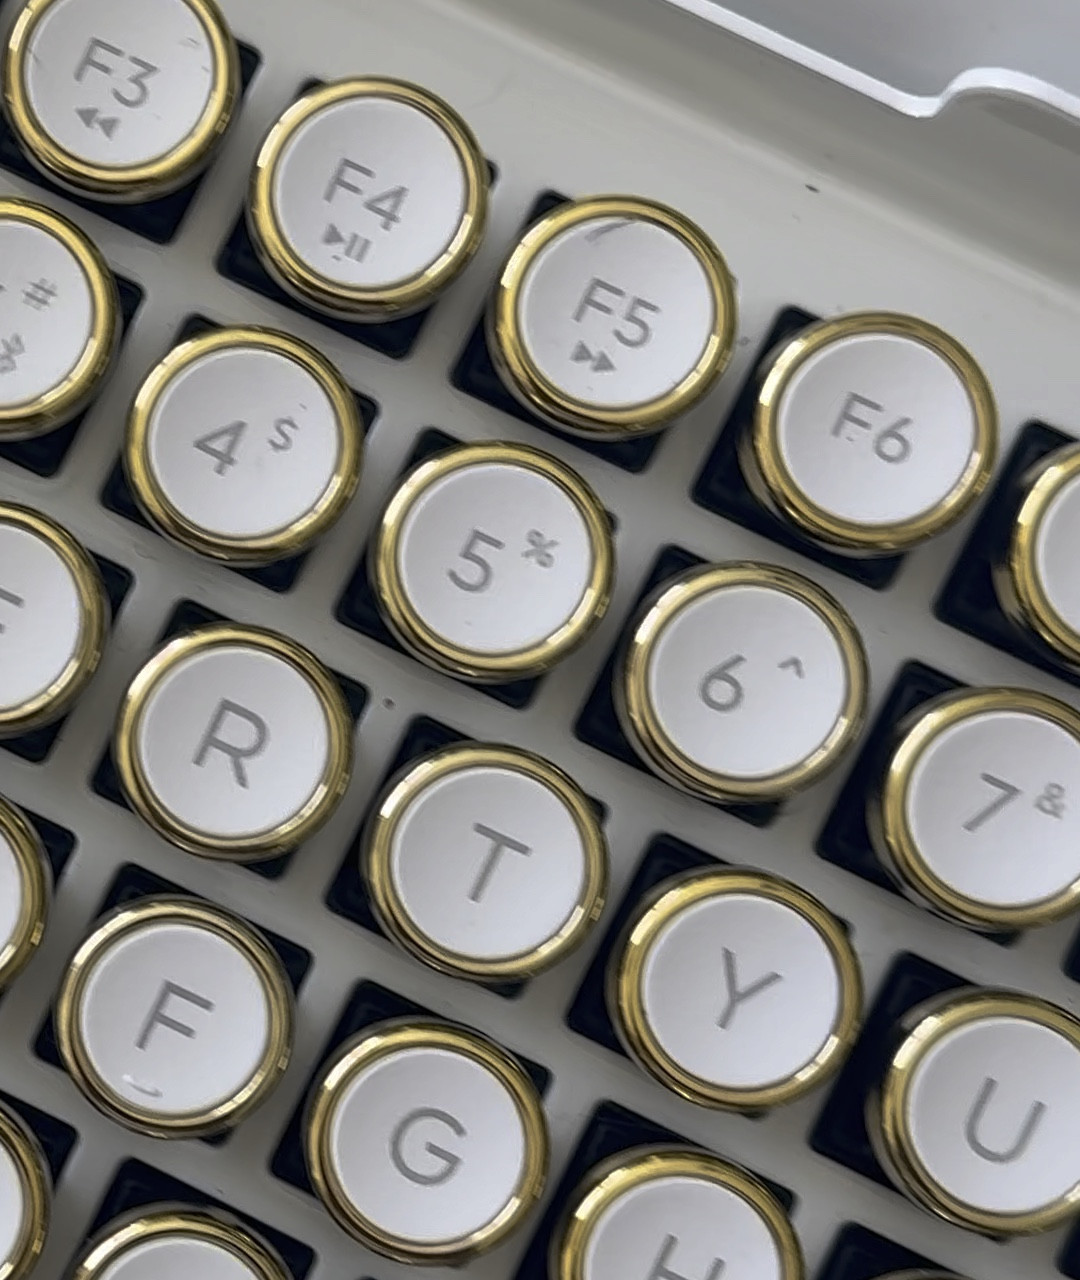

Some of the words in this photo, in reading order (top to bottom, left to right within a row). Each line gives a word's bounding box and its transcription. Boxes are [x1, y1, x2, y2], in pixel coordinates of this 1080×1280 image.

[73, 36, 159, 109] F3
[323, 157, 410, 232] F4
[571, 276, 663, 349] F5
[192, 420, 248, 476] 4
[830, 390, 913, 465] F6
[447, 528, 506, 593] 5
[698, 653, 748, 713] 6
[192, 698, 269, 789] R
[961, 771, 1023, 832] 7
[472, 821, 533, 903] T
[135, 979, 215, 1050] F
[716, 946, 784, 1030] Y
[388, 1106, 469, 1186] G
[964, 1076, 1047, 1164] U
